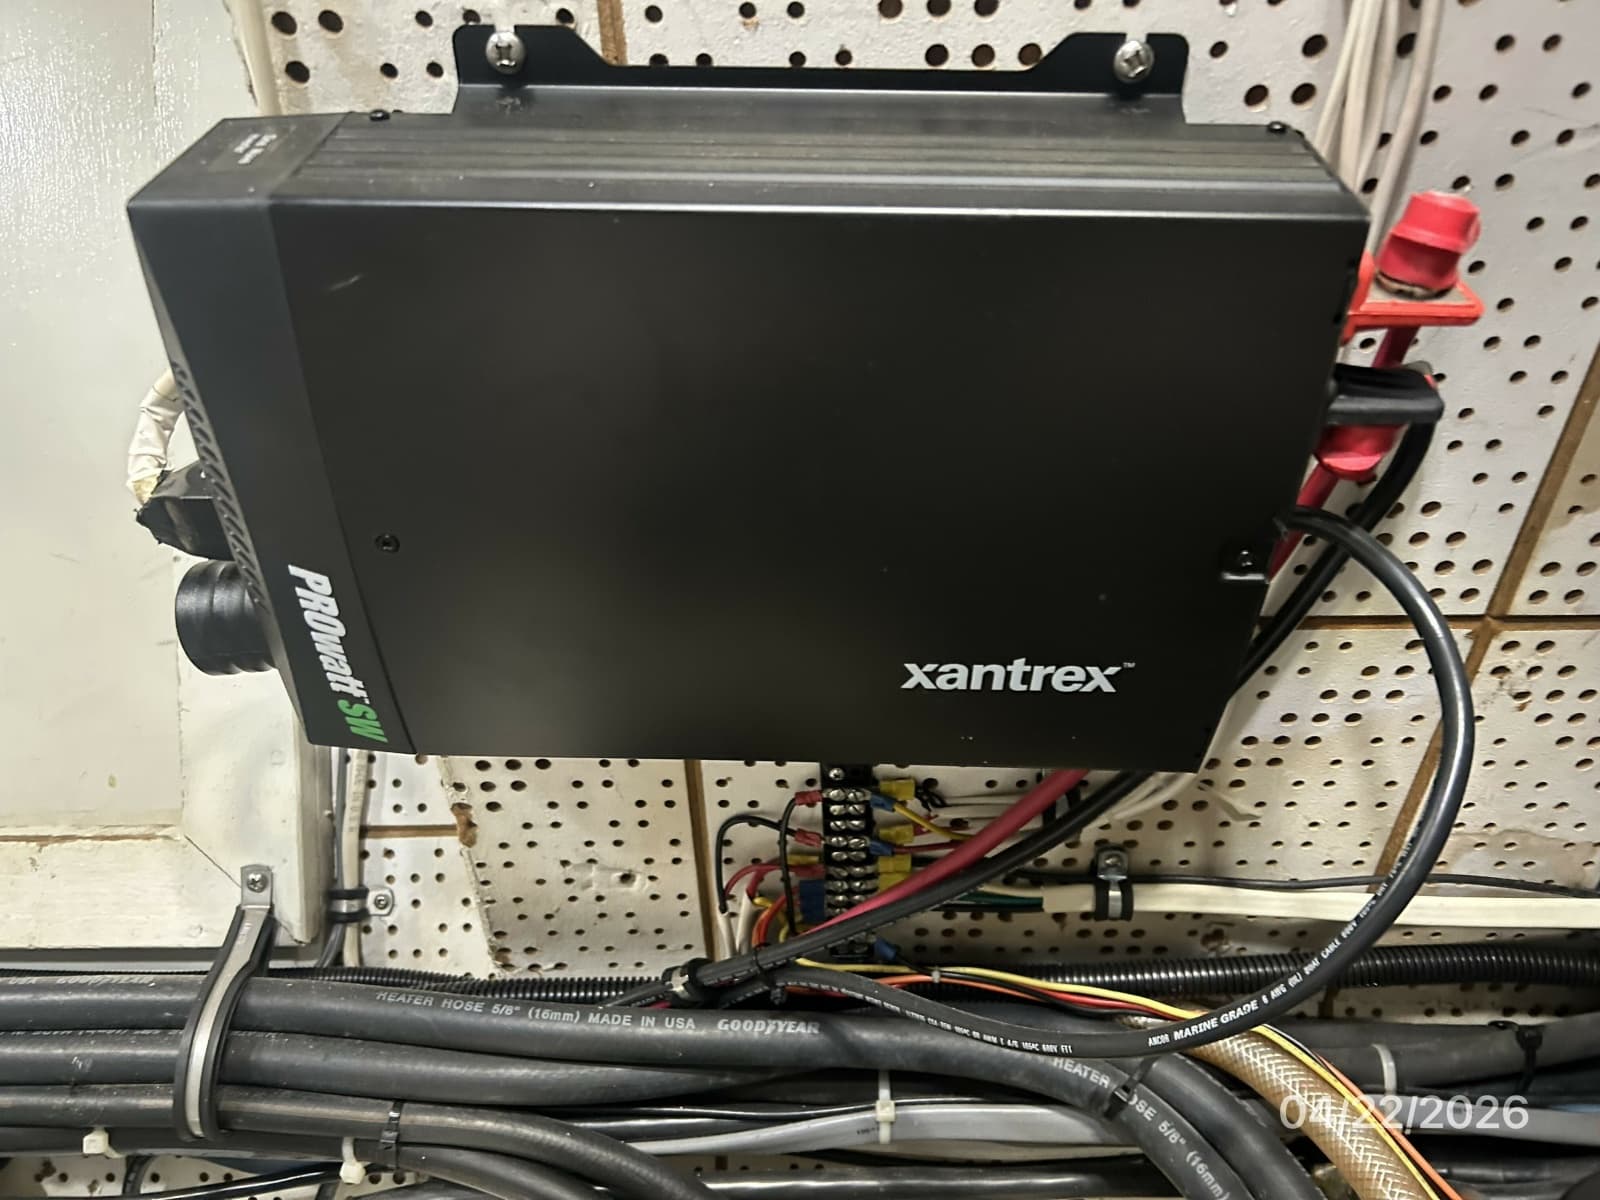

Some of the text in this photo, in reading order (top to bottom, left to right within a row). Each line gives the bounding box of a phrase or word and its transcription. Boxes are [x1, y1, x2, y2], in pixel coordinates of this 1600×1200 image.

[338, 700, 389, 743] SW
[376, 991, 434, 1006] HEATER
[440, 998, 485, 1013] HOSE
[527, 1006, 580, 1023] (16mm)
[588, 1012, 632, 1026] MADE
[640, 1015, 655, 1027] IN
[664, 1017, 696, 1029] USA
[1173, 1017, 1219, 1041] MARINE
[1220, 999, 1260, 1024] GRADE
[1053, 1058, 1111, 1088] HEATER
[1185, 1150, 1231, 1200] (16mm)
